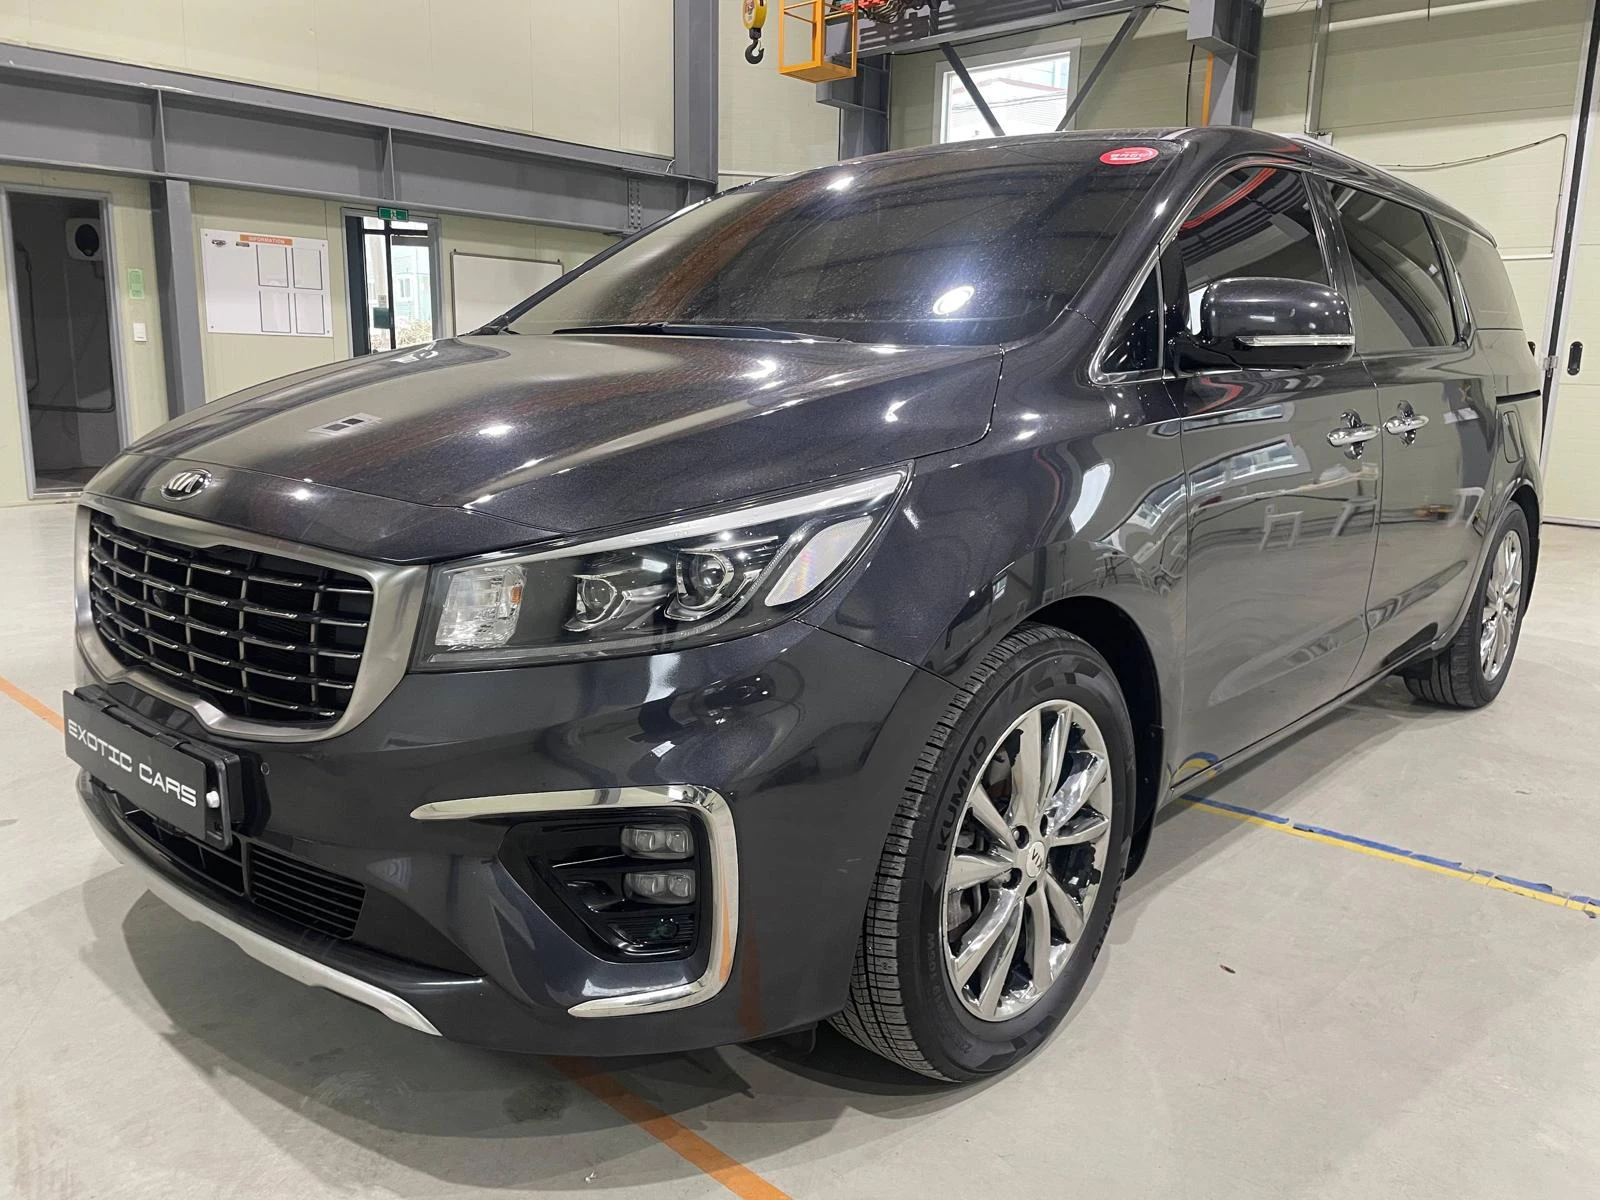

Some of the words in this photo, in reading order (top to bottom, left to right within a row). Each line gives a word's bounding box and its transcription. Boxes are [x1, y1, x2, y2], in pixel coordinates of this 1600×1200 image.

[248, 236, 286, 244] INFORMATION
[68, 719, 132, 772] EXOTIC
[139, 763, 197, 807] CARS
[936, 735, 987, 851] KUMHO
